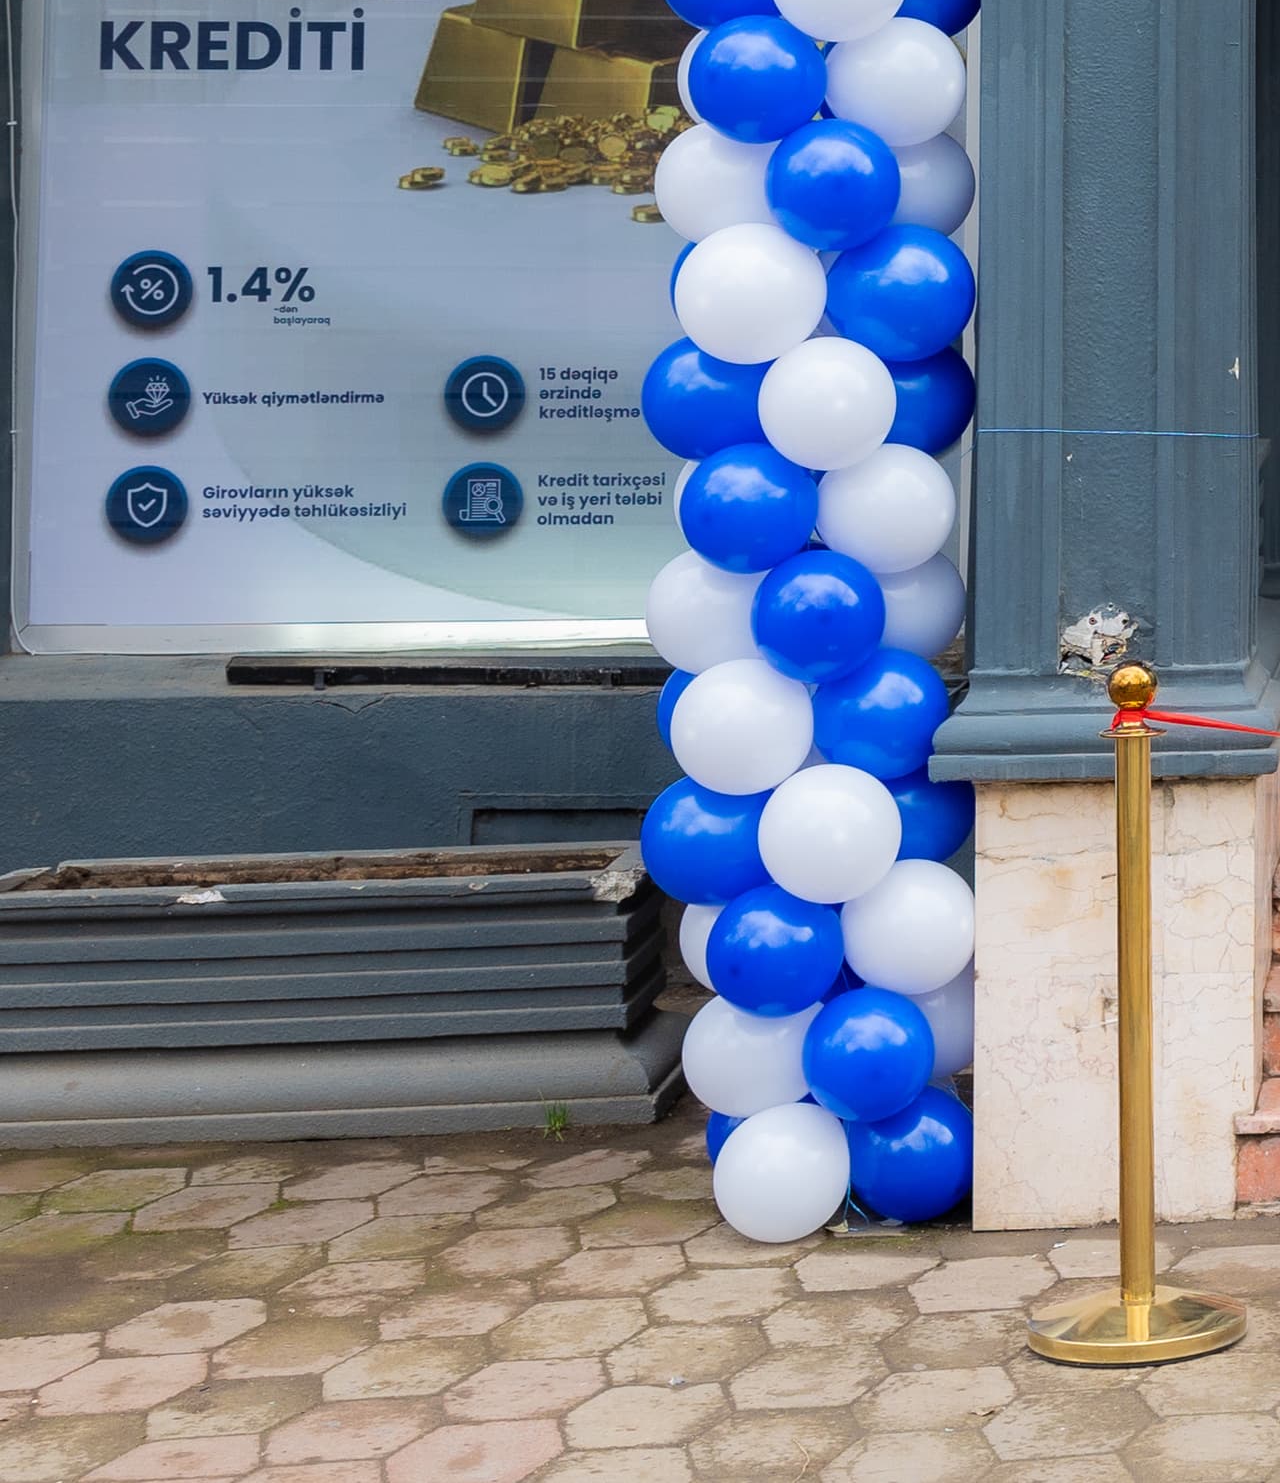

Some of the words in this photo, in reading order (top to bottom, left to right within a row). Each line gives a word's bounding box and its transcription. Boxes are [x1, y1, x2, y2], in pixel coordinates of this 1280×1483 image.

[100, 7, 365, 71] KREDİTİ
[207, 266, 316, 303] 1.4%
[273, 315, 331, 327] başlayaraq
[539, 367, 556, 381] 15
[560, 367, 619, 385] dəqiqə
[203, 390, 258, 405] Yüksək
[262, 390, 385, 408] qiymətləndirmə
[539, 385, 602, 400] ərzində
[539, 404, 641, 423] kreditləşmə
[538, 472, 589, 488] Kredit
[592, 472, 666, 491] tarixçəsi
[203, 485, 289, 500] Girovların
[293, 485, 354, 503] yüksək
[538, 494, 558, 507] və
[562, 492, 575, 510] iş
[578, 492, 610, 510] yeri
[614, 492, 663, 507] tələbi
[202, 503, 290, 520] səviyyədə
[294, 502, 407, 521] təhlükəsizliyi
[537, 511, 614, 526] olmadan
